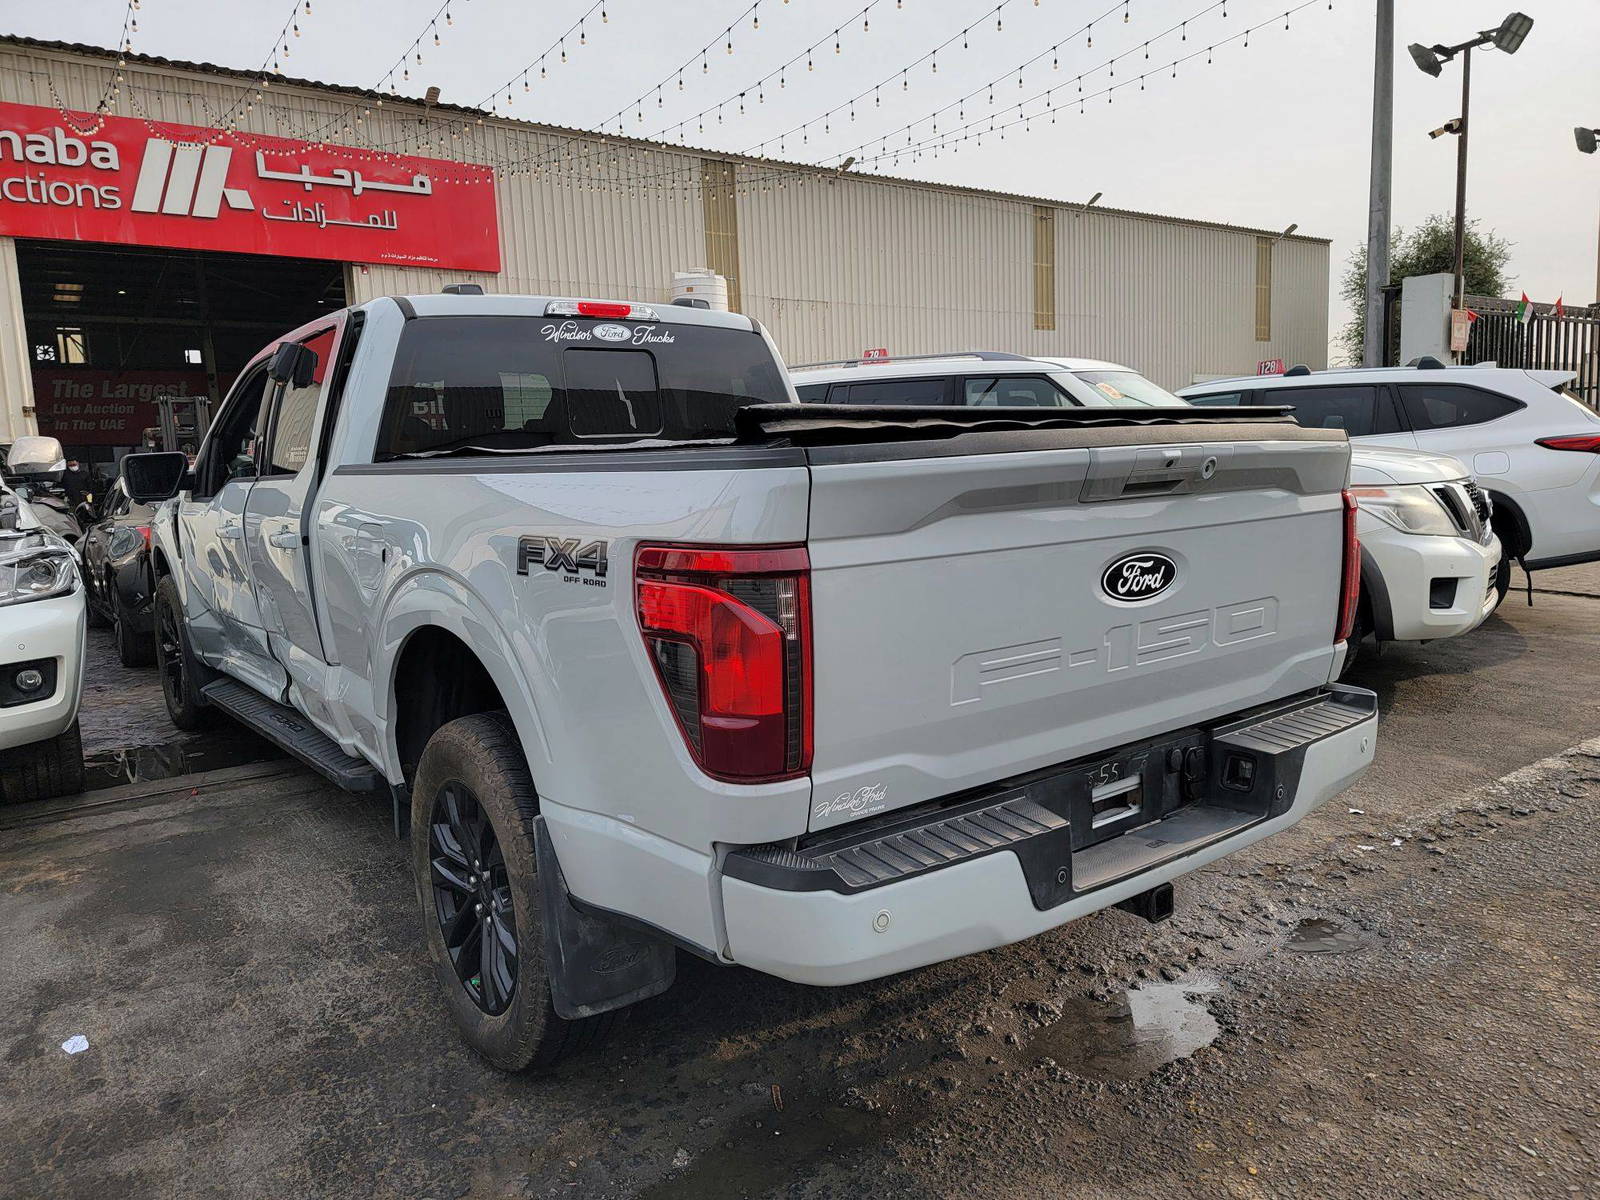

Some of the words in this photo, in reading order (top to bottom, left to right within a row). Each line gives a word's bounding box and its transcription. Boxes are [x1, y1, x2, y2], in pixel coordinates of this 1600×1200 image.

[0, 172, 122, 209] ctions
[540, 321, 592, 342] Windsor
[631, 325, 675, 345] Trucks
[1260, 360, 1276, 375] 128
[52, 379, 95, 399] The
[102, 380, 188, 402] Largest
[53, 403, 82, 415] Live
[83, 403, 136, 415] Auction
[55, 419, 69, 431] In
[71, 419, 97, 431] The
[100, 418, 127, 431] UAE
[517, 535, 608, 577] FX4
[563, 575, 581, 584] OFF
[583, 578, 607, 587] ROAD
[1117, 560, 1165, 595] Ford
[950, 596, 1280, 706] F-150
